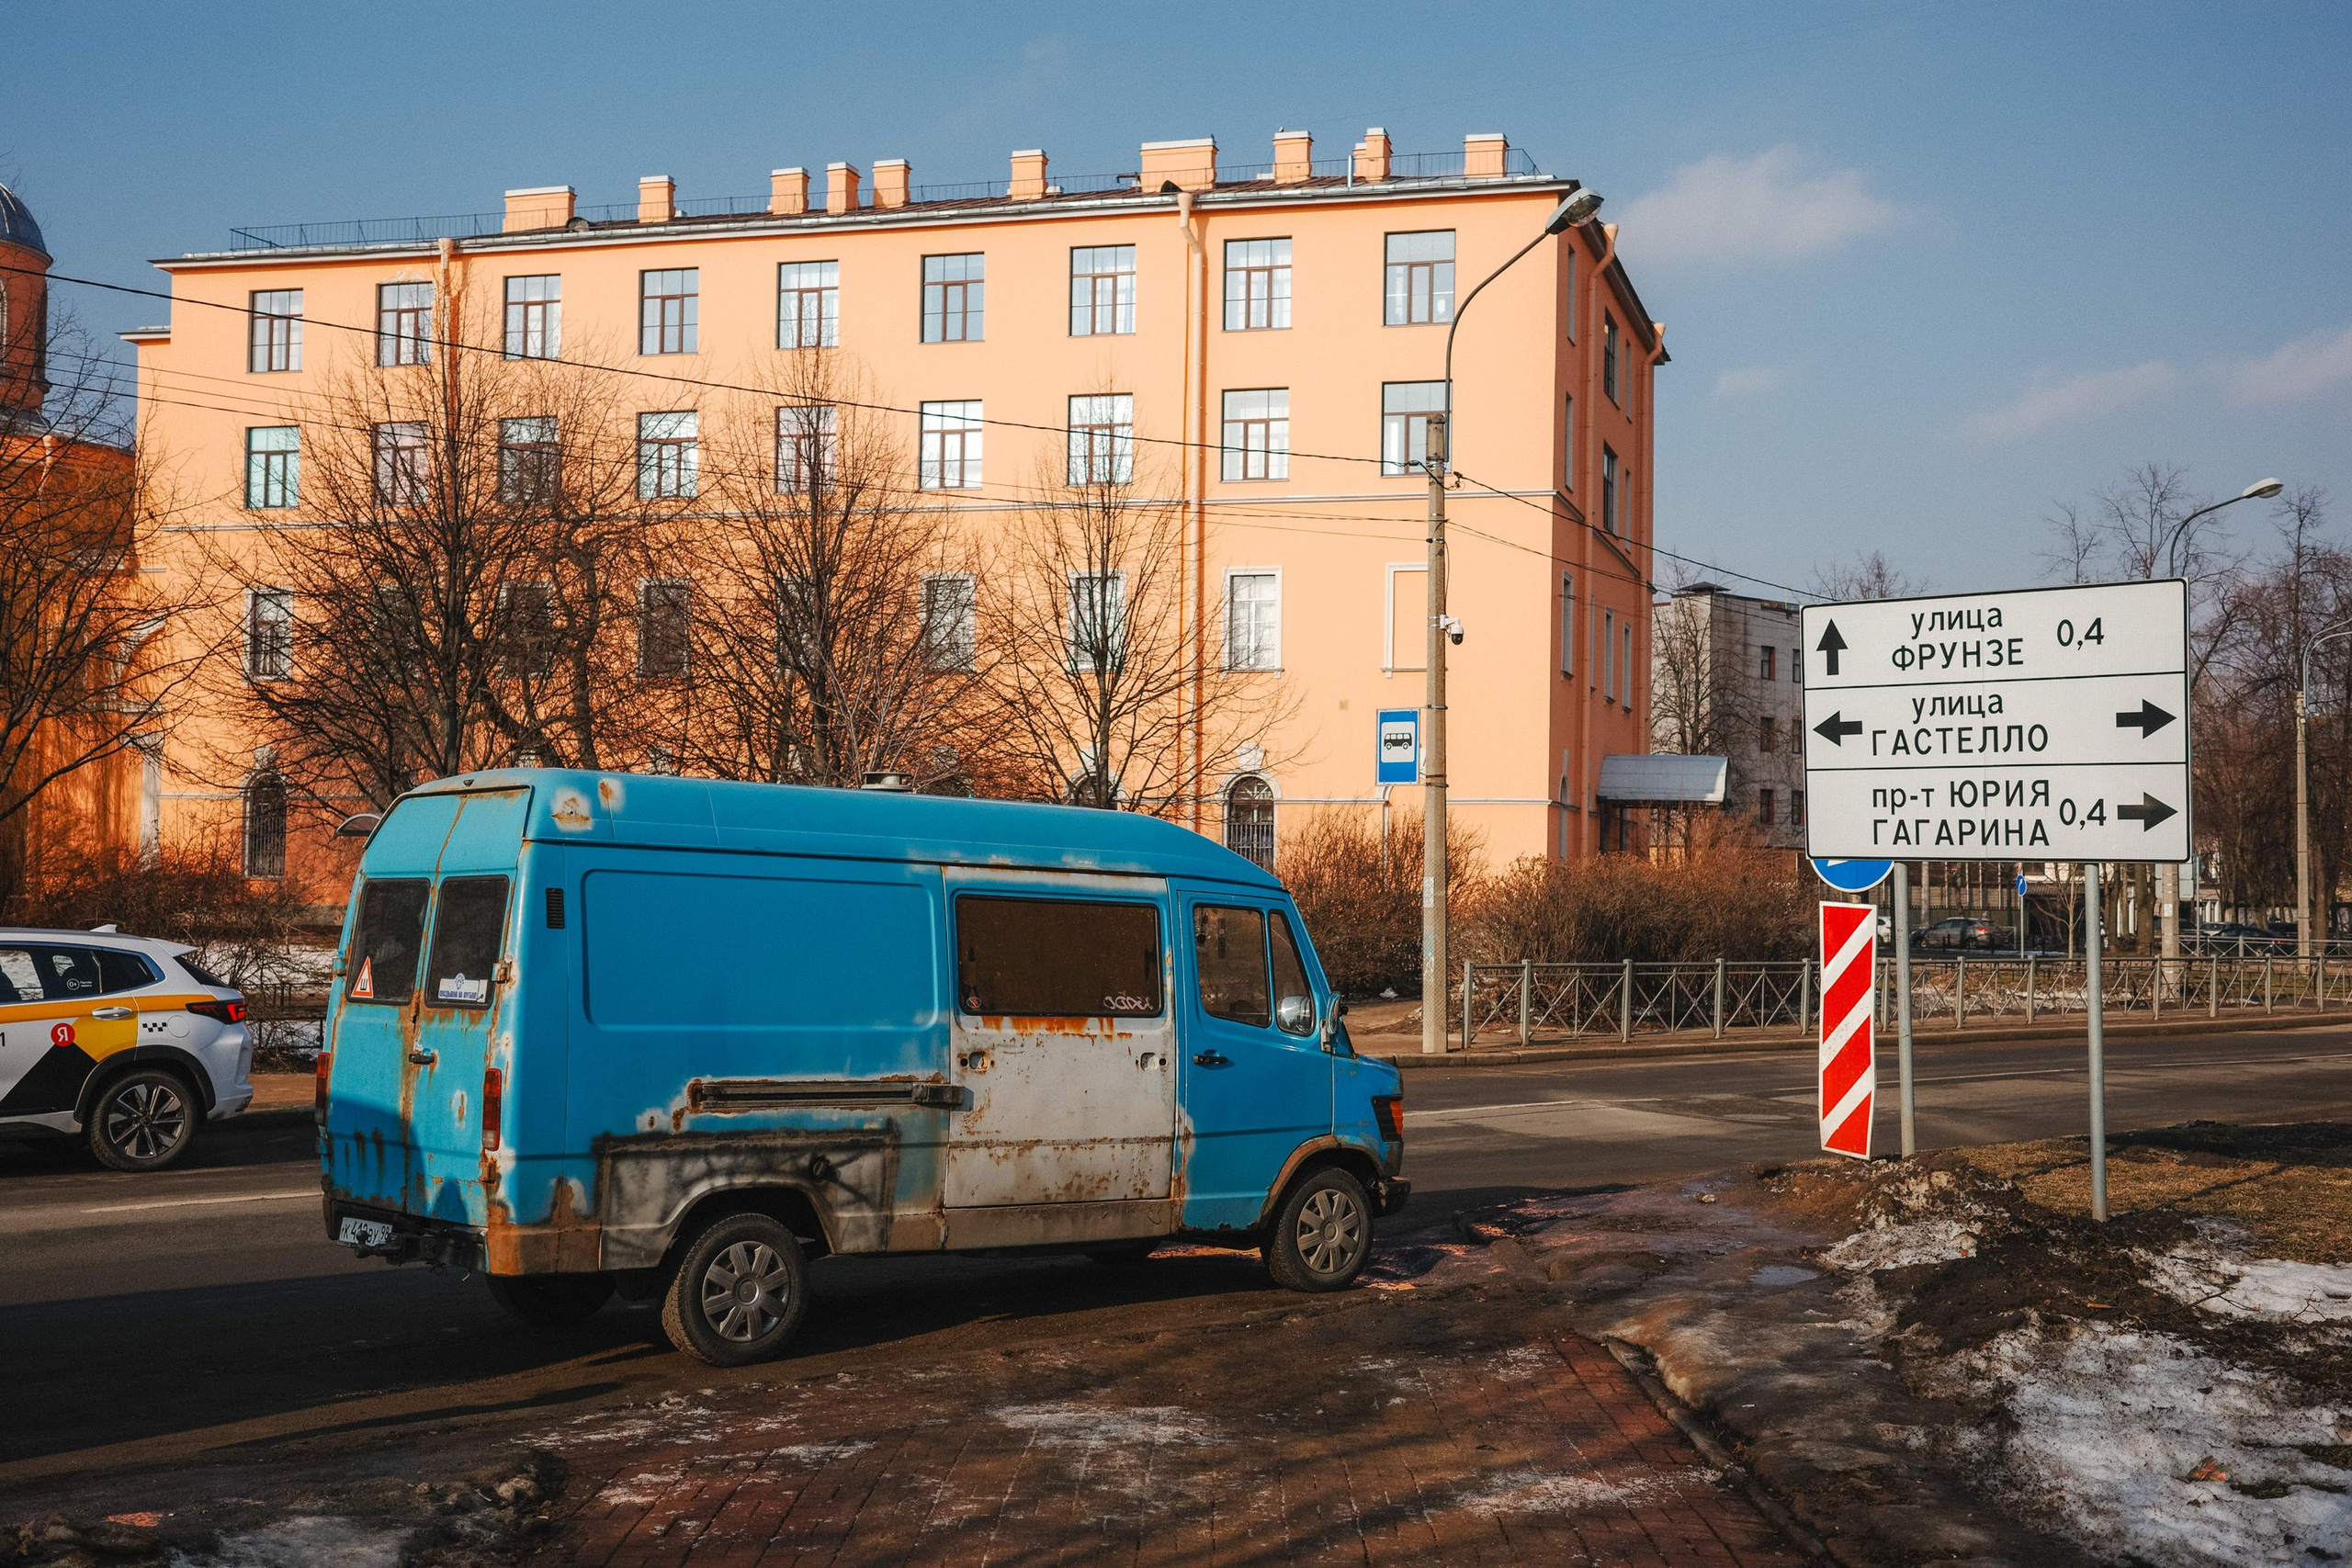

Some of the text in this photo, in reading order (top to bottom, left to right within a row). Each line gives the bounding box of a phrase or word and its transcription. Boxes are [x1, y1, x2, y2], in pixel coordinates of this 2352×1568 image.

[1911, 607, 2003, 640] улица
[2056, 616, 2105, 651] 0,4
[1892, 637, 2024, 671] ФРУНЗЕ
[1912, 694, 2004, 725] улица
[1871, 724, 2049, 756] ГАСТЕЛЛО
[1872, 779, 2050, 816] пр-т ЮРИЯ
[2059, 797, 2108, 830] 0,4
[1873, 818, 2050, 847] ГАГАРИНА
[57, 1026, 69, 1043] Я
